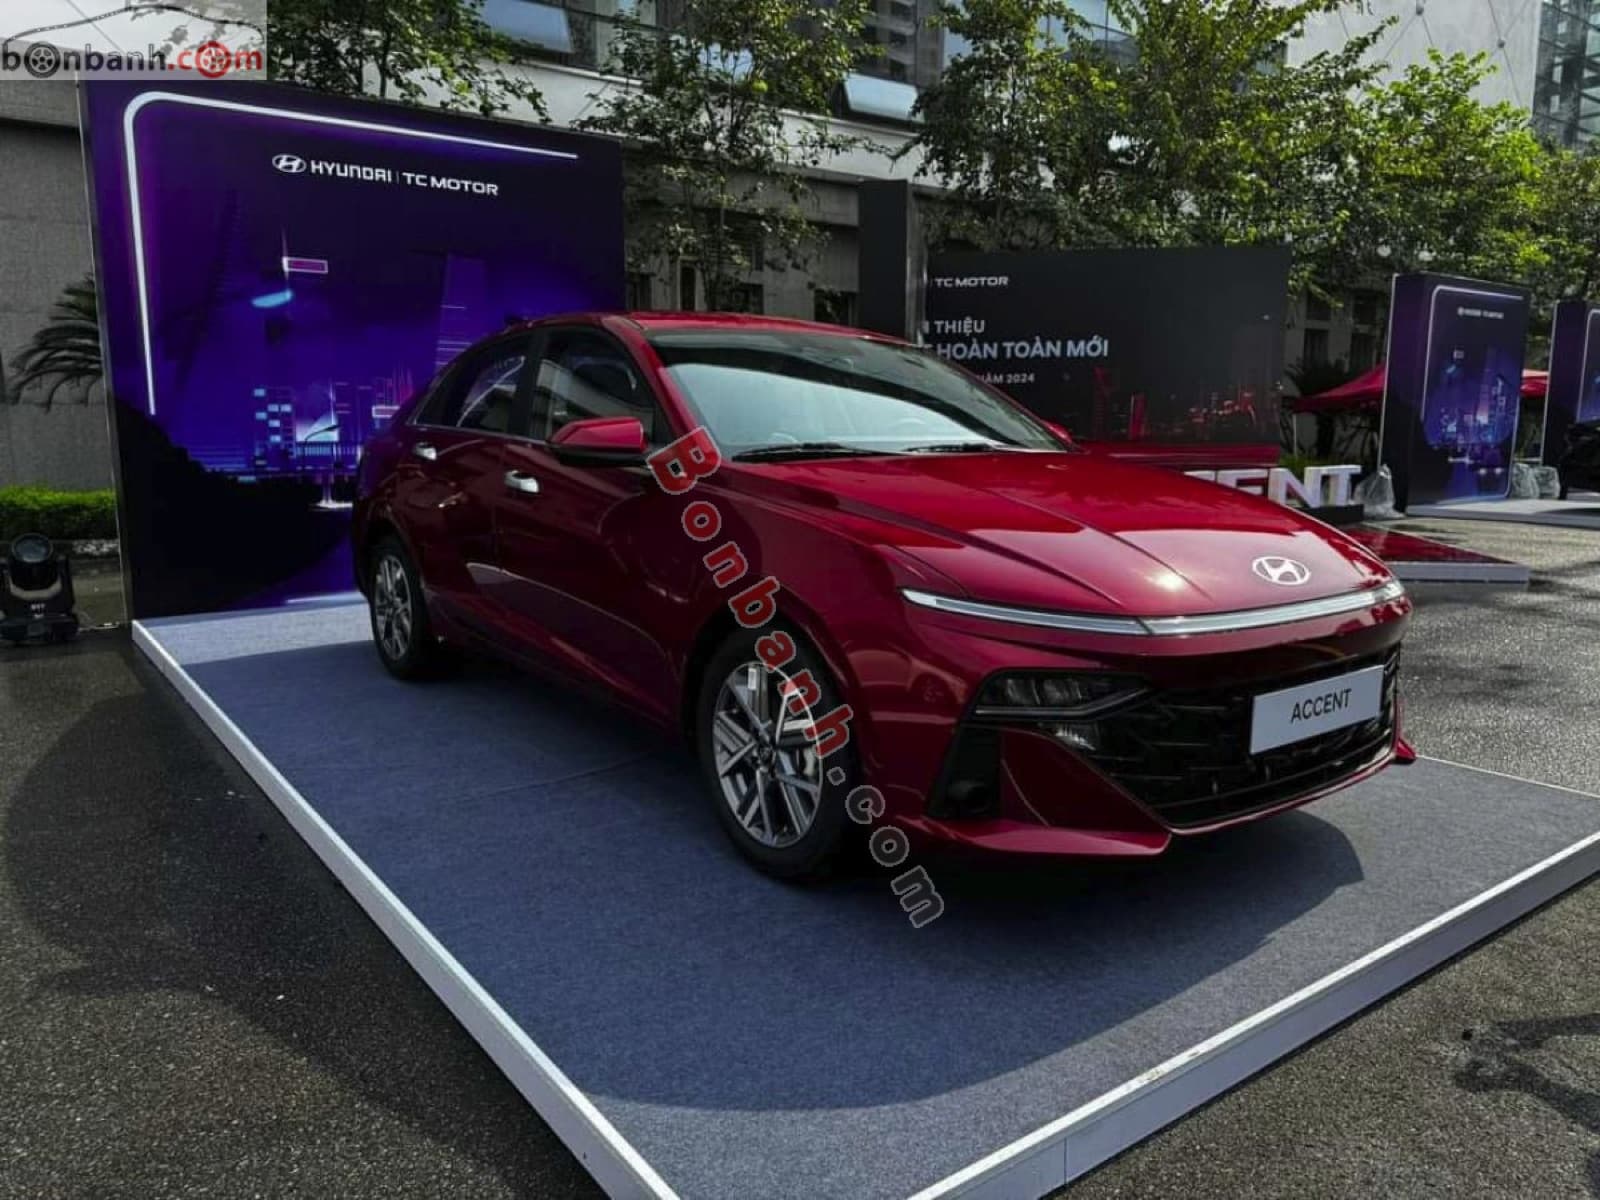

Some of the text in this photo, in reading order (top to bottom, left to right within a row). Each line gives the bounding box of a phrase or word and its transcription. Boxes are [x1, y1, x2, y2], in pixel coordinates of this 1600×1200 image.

[310, 160, 499, 196] HYUNDAI TC MOTOR
[935, 276, 1009, 288] TC MOTOR
[934, 316, 985, 336] THIỆU
[937, 334, 1109, 361] HOÀN TOÀN MỚI
[1006, 373, 1035, 384] 2024
[1184, 464, 1361, 508] ENT
[1291, 688, 1352, 723] ACCENT
